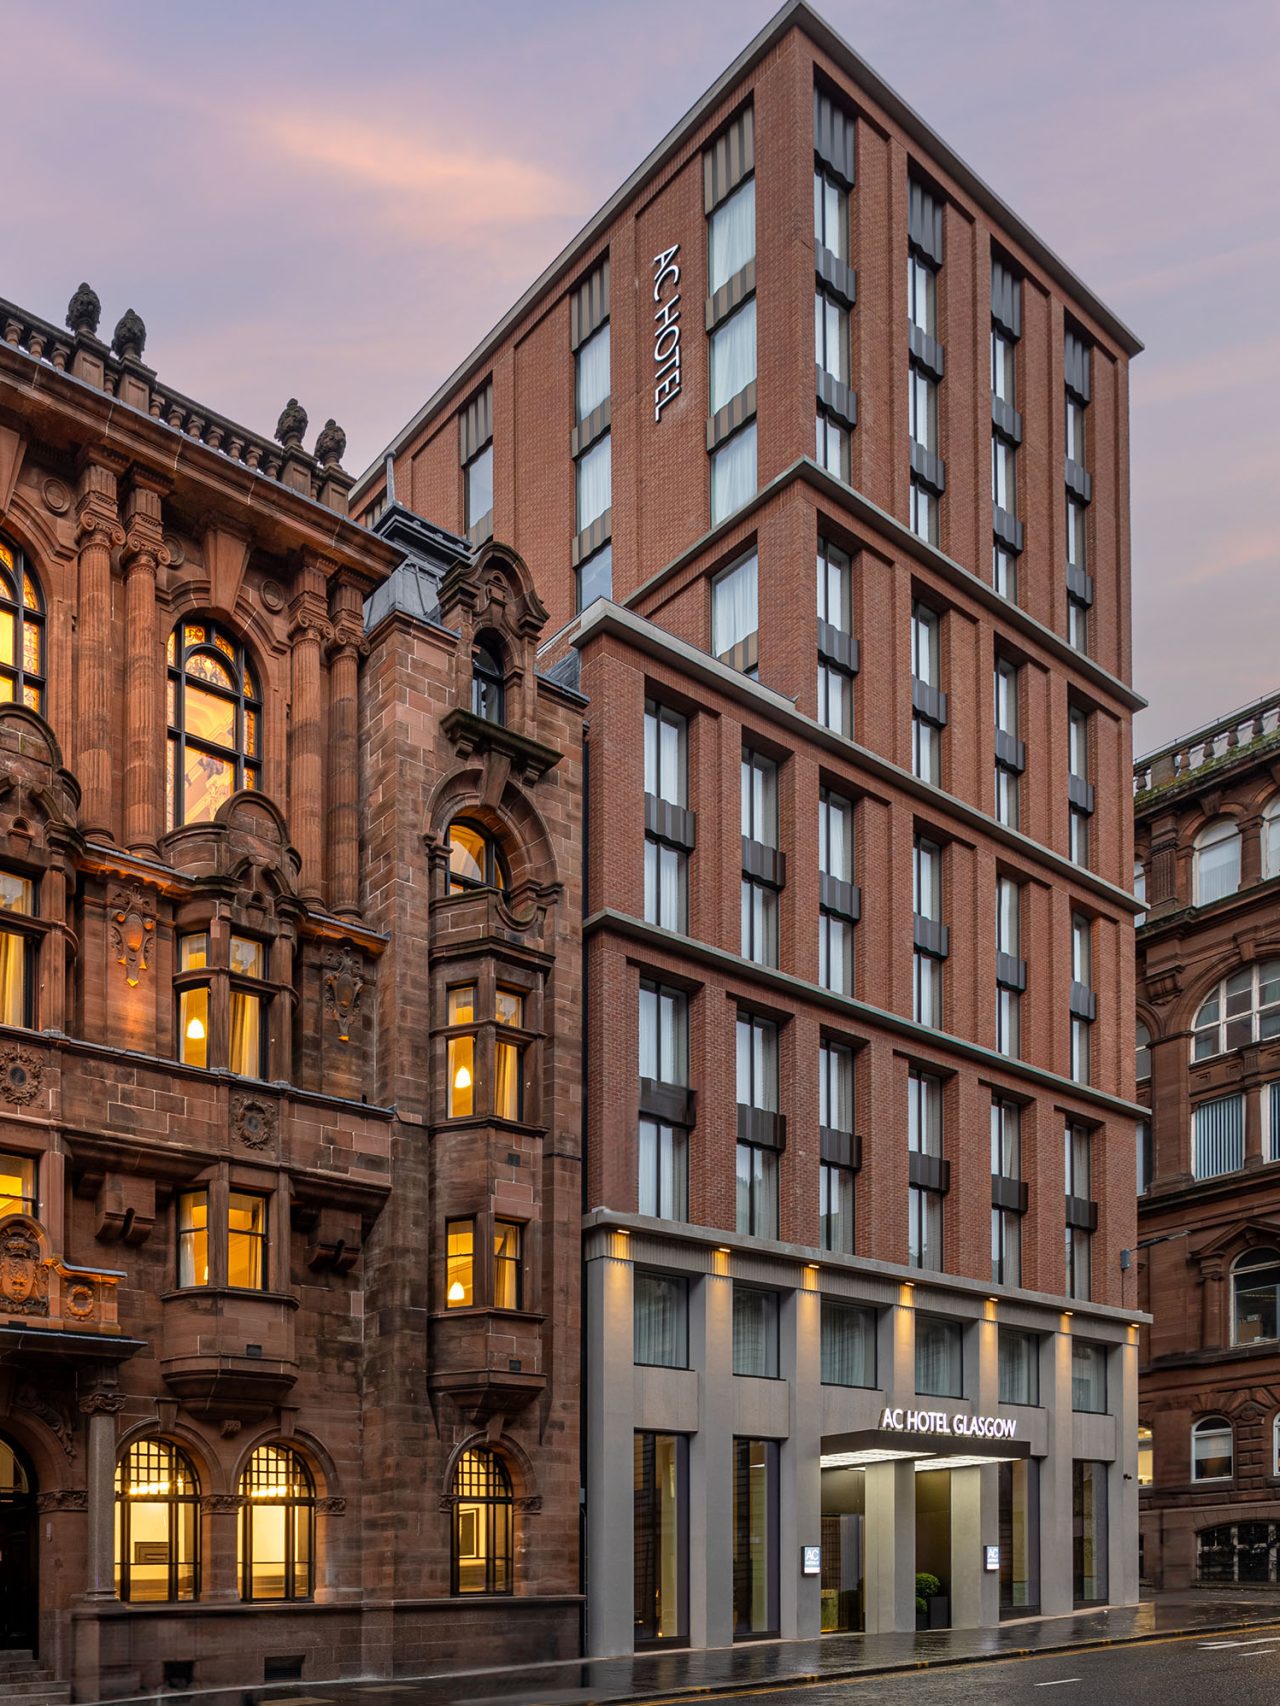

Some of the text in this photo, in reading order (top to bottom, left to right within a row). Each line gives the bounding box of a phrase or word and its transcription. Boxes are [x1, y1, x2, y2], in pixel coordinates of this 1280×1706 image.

[654, 244, 680, 421] AC HOTEL
[882, 1407, 1017, 1438] AC HOTEL GLASGOW
[806, 1549, 819, 1561] AC
[988, 1548, 999, 1559] AC
